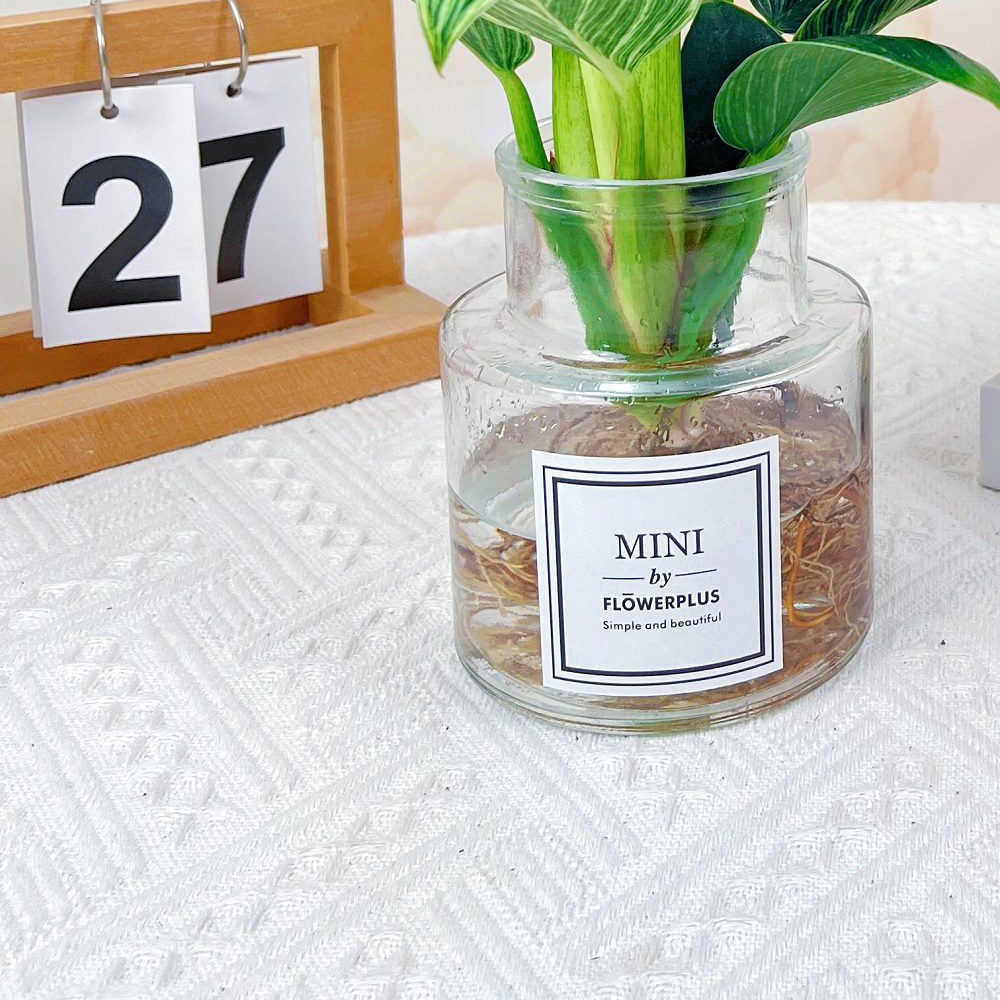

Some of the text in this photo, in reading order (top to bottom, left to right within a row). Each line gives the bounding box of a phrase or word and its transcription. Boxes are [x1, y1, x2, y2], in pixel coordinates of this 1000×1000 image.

[614, 528, 705, 560] MINI
[649, 568, 672, 588] by
[602, 612, 722, 632] Simple and beautiful
